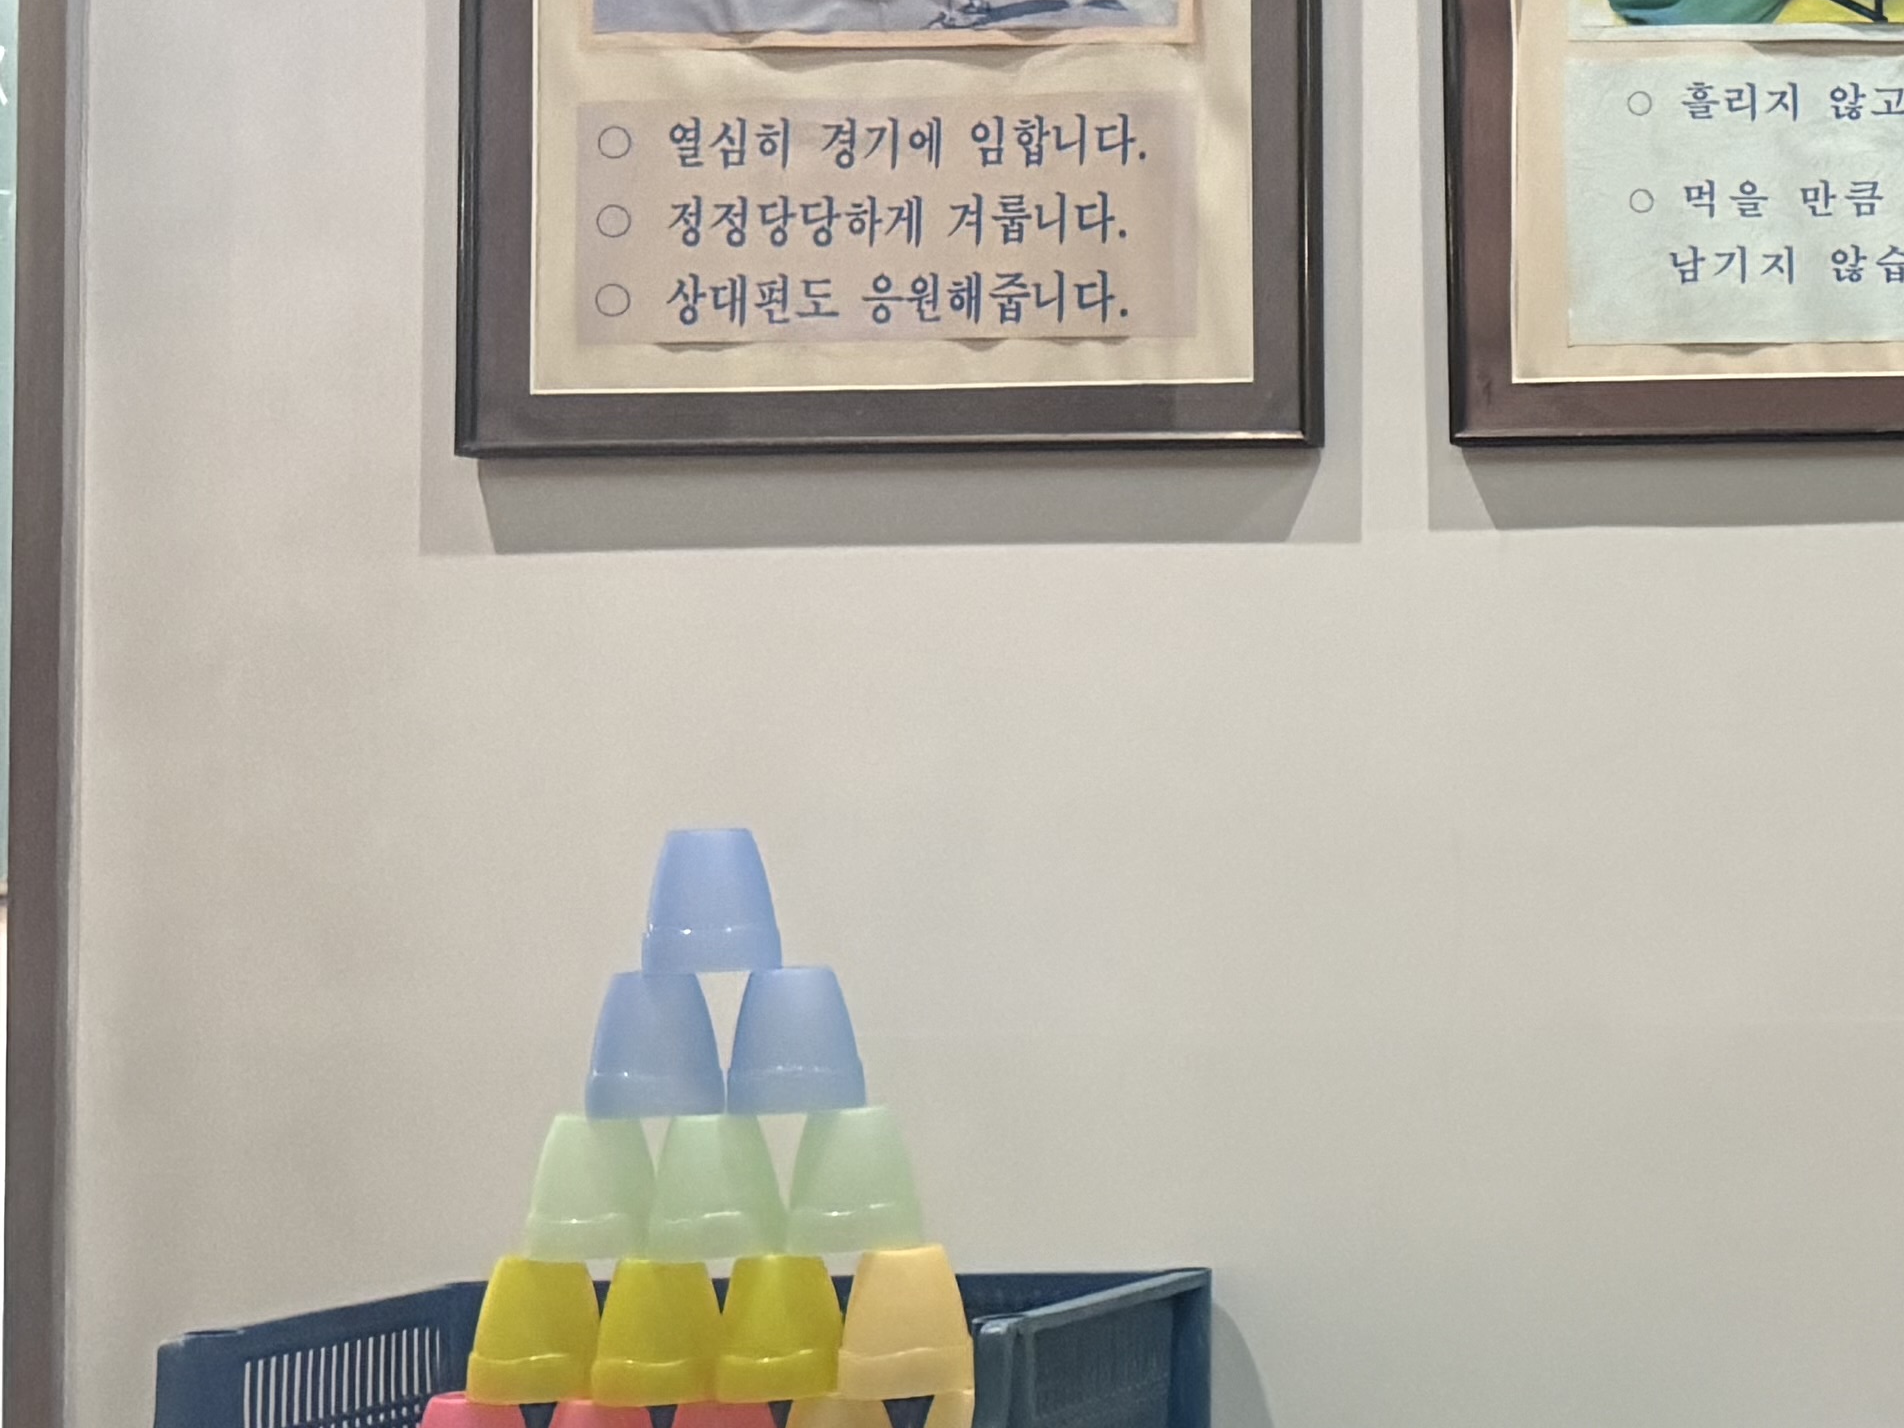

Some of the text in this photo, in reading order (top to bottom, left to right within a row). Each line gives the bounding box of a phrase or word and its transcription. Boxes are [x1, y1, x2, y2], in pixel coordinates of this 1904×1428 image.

[1681, 81, 1798, 122] 흘리지
[668, 112, 1147, 170] 열심히 경기에 임합니다.
[668, 190, 1127, 248] 정정당당하게 겨룹니다.
[1683, 178, 1769, 219] 먹을
[1799, 179, 1884, 218] 만큼
[1668, 244, 1794, 285] 남기지
[666, 268, 1129, 328] 상대편도 응원해줍니다.
